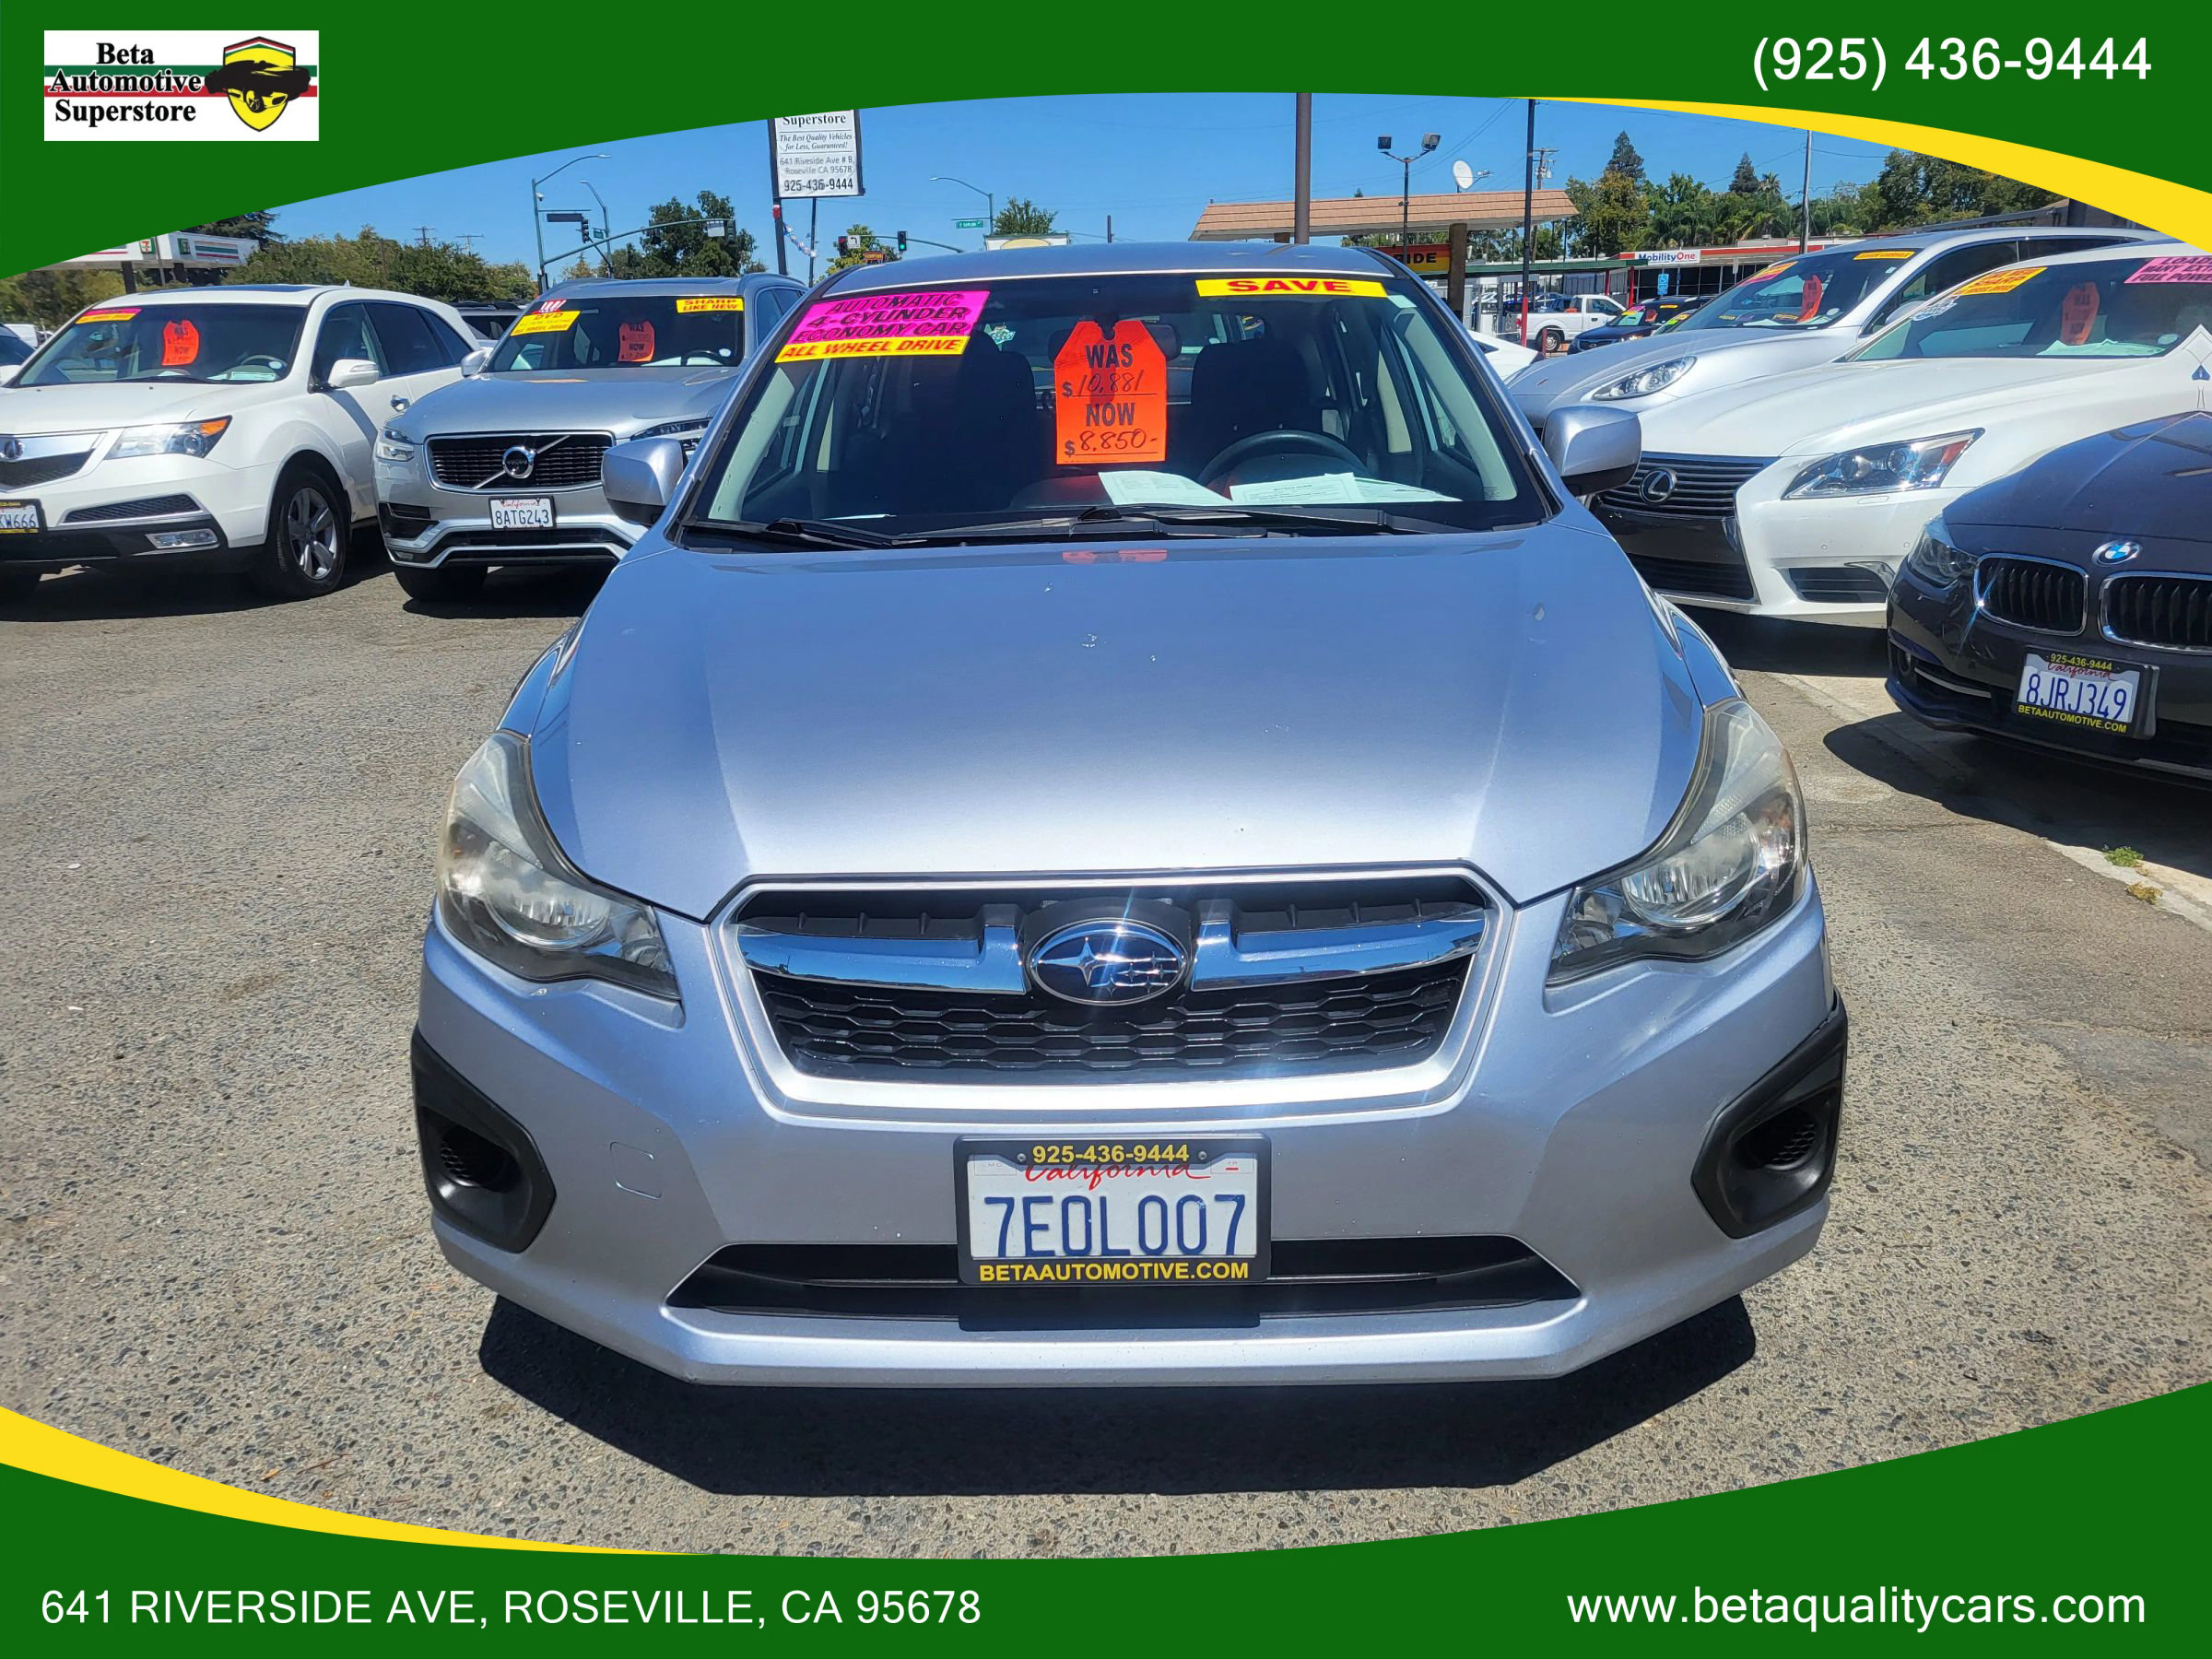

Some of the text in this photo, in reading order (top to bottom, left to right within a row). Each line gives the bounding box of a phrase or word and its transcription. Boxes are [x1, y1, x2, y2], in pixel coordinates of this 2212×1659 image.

[782, 114, 846, 128] Superstore
[806, 134, 828, 143] Quality
[811, 142, 848, 150] Guaranteed!
[780, 158, 793, 166] 641
[785, 165, 852, 175] Roseville CA 95678
[783, 178, 853, 192] 925-436-9444
[1228, 279, 1353, 293] SAVE
[828, 293, 964, 314] AUTOMATIC
[792, 323, 971, 343] ECONOMY CAR
[782, 339, 961, 358] ALL WHEEL DRIVE
[1086, 343, 1134, 369] WAS
[1086, 402, 1135, 427] NOW
[495, 509, 550, 525] 8ATG243
[2050, 653, 2112, 671] 925-436-9444
[2047, 662, 2119, 682] California
[2026, 674, 2127, 720] 8JRJ349
[2018, 704, 2127, 734] BETAAUTOMOTIVE.COM
[1032, 1144, 1189, 1164] 925-436-9444
[1025, 1163, 1211, 1191] California
[979, 1262, 1250, 1283] BETAAUTOMOTIVE.COM
